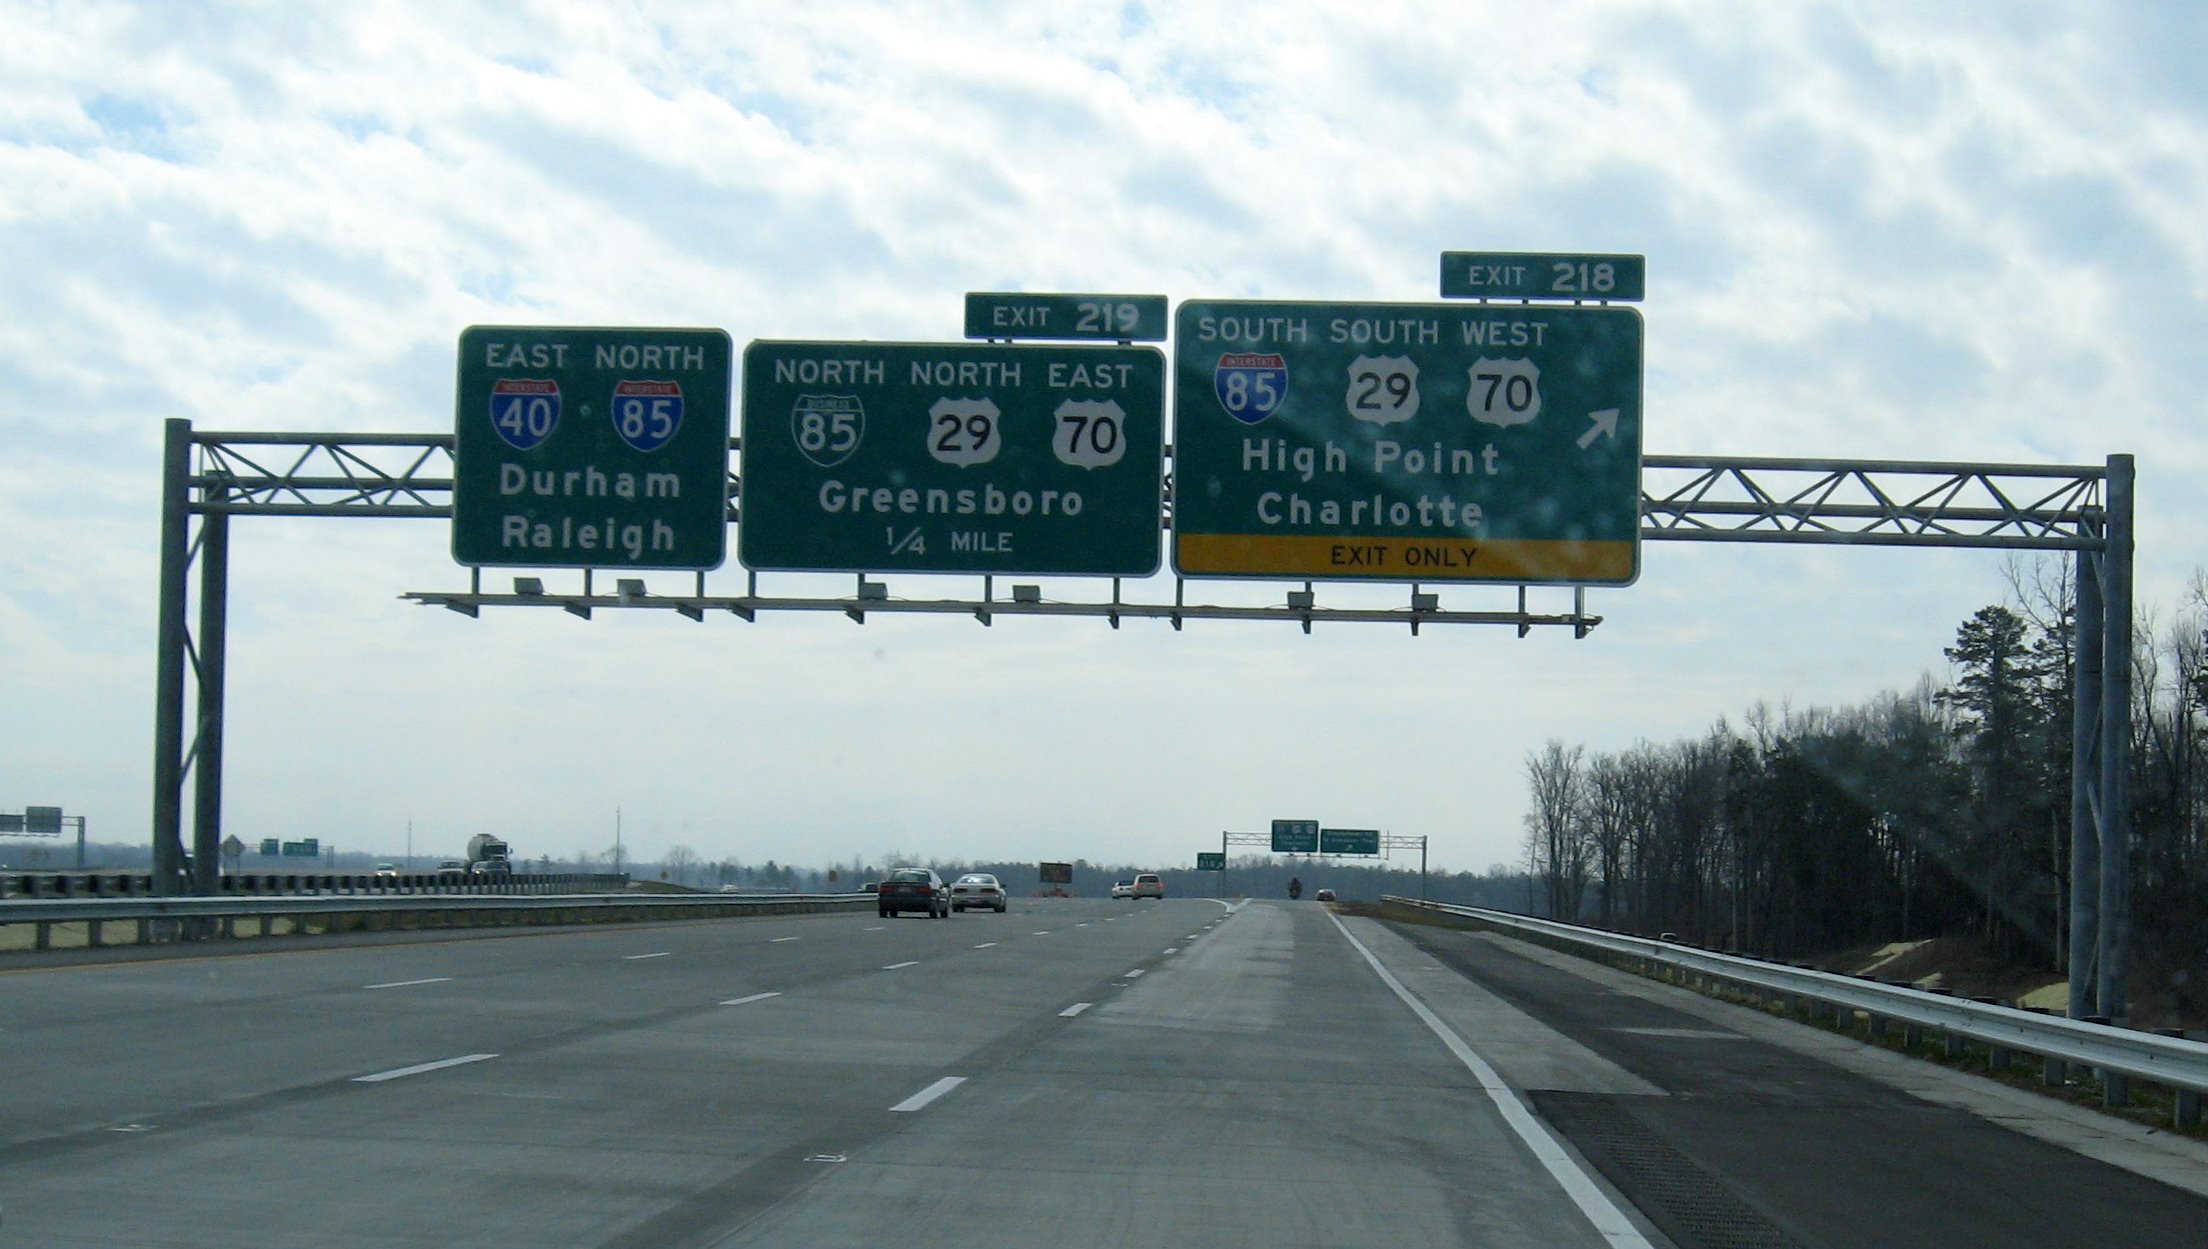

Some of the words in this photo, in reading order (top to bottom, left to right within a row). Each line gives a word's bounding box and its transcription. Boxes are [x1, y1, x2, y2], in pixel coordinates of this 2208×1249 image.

[1469, 266, 1526, 285] EXIT
[1552, 263, 1615, 292] 218
[994, 307, 1050, 326] EXIT
[1076, 303, 1140, 332] 219
[1198, 317, 1307, 342] SOUTH
[1331, 319, 1439, 344] SOUTH
[1461, 321, 1549, 346] WEST
[486, 344, 568, 367] EAST
[596, 344, 704, 370] NORTH
[776, 359, 884, 384] NORTH
[911, 361, 1020, 387] NORTH
[1048, 363, 1133, 388] EAST
[1225, 372, 1276, 412] 85
[1356, 371, 1410, 410] 29
[1476, 374, 1532, 412] 70
[500, 398, 552, 437] 40
[622, 400, 672, 439] 85
[799, 413, 857, 452] 85
[937, 414, 990, 451] 29
[1063, 416, 1117, 454] 70
[1243, 438, 1346, 482] High
[1375, 441, 1499, 476] Point
[500, 463, 680, 497] Durham
[819, 480, 1083, 516] Greensboro
[1257, 492, 1483, 528] Charlotte
[502, 516, 674, 560] Raleigh
[951, 532, 1013, 552] MILE
[1331, 546, 1387, 566] EXIT
[1405, 548, 1477, 568] ONLY
